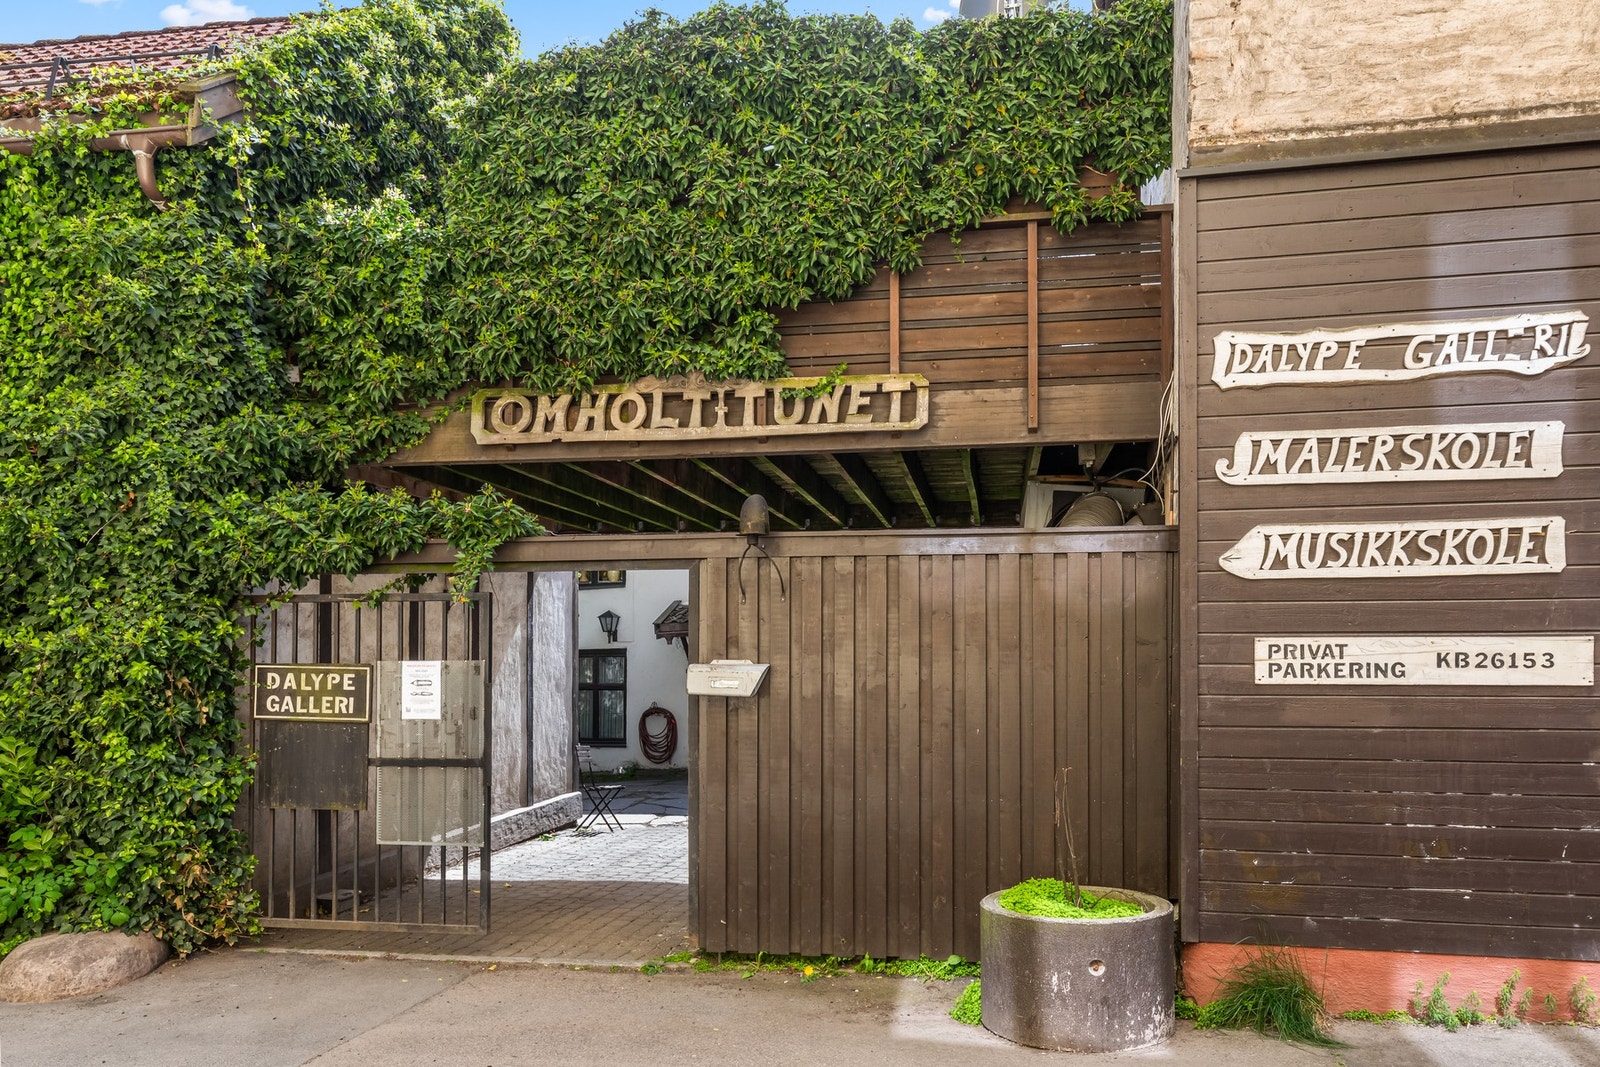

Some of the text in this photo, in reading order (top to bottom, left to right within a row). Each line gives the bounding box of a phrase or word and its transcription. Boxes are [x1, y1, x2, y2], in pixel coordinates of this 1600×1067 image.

[1231, 339, 1367, 374] DALYPE
[1253, 431, 1530, 474] MALERSKOLE
[1261, 525, 1543, 570] MUSIKKSKOLE
[1268, 643, 1348, 660] PRIVAT
[1436, 651, 1555, 669] KB26153
[1268, 662, 1406, 679] PARKERING
[266, 672, 356, 691] DALYPE
[266, 695, 354, 714] GALLERI
